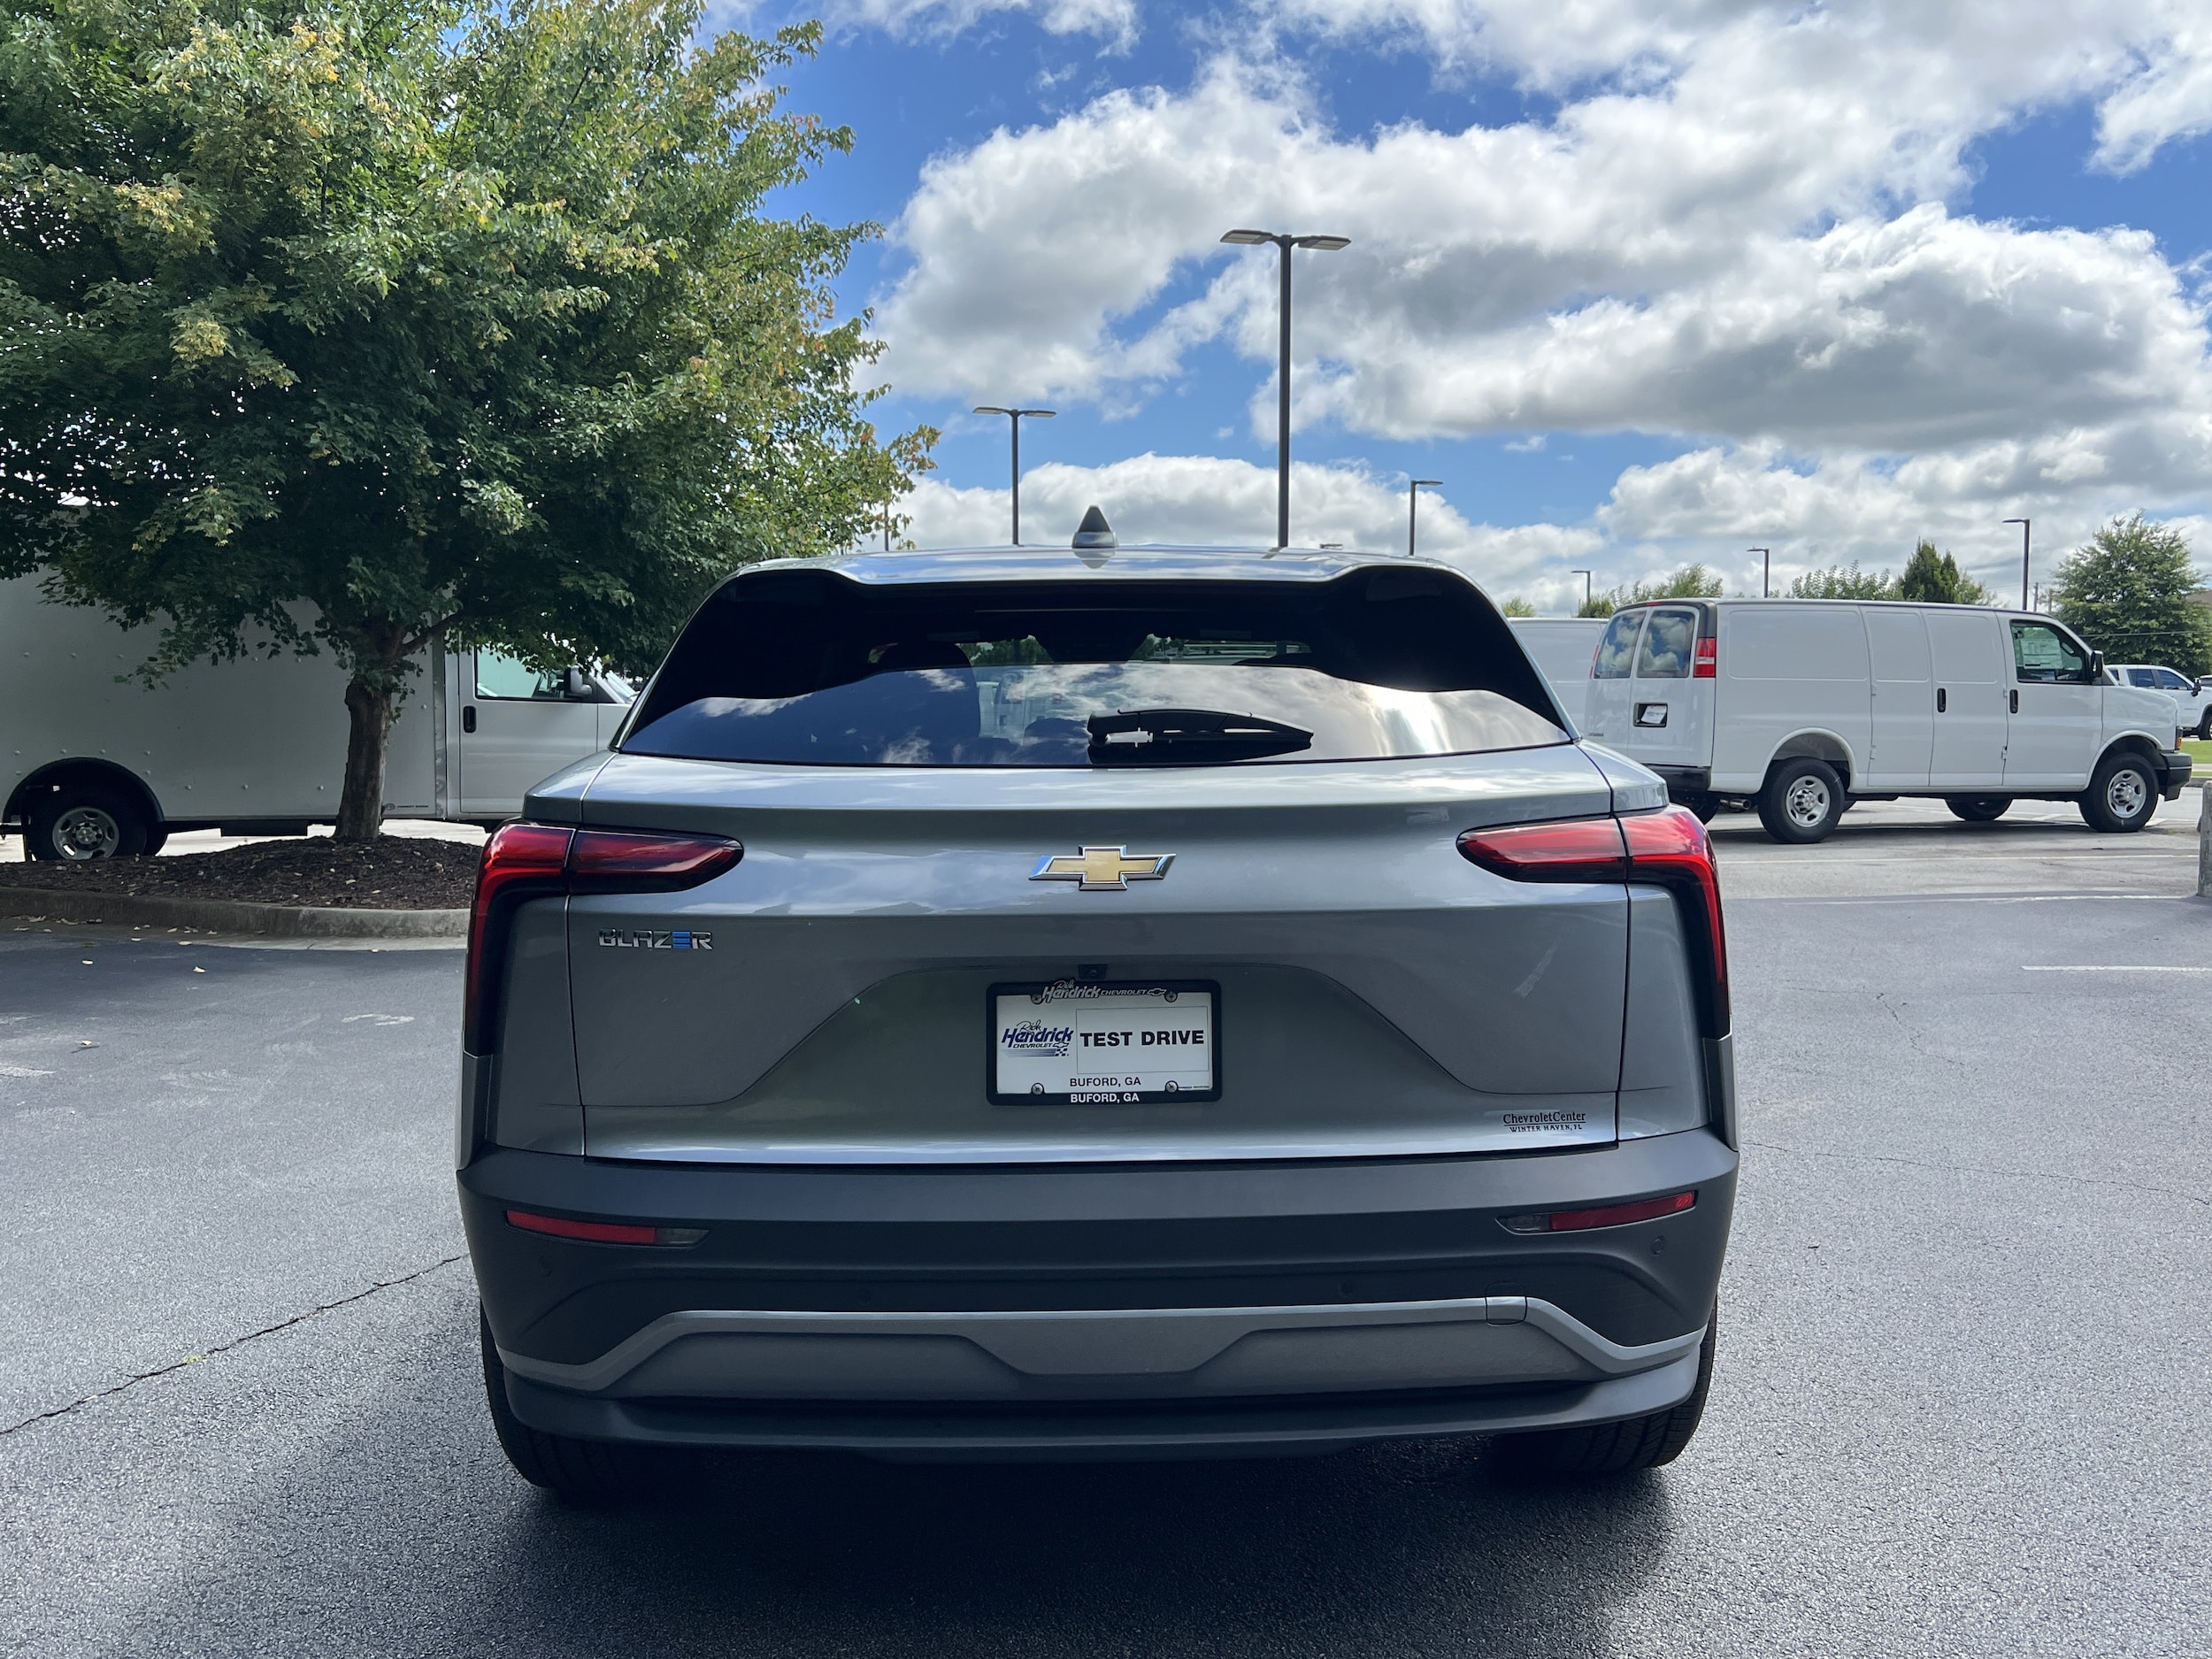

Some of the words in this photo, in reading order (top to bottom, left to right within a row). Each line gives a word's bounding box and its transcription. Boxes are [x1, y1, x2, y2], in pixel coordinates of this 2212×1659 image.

[599, 929, 713, 950] BLAZER
[1042, 986, 1100, 1003] Hendrick
[1016, 1019, 1041, 1033] Rick
[1001, 1026, 1074, 1048] Hendrick
[1079, 1032, 1133, 1048] TEST
[1141, 1030, 1204, 1046] DRIVE
[1070, 1078, 1121, 1087] BUFORD,
[1125, 1077, 1141, 1086] GA
[1070, 1093, 1120, 1103] BUFORD,
[1123, 1093, 1140, 1102] GA
[1503, 1111, 1586, 1124] ChevroletCenter
